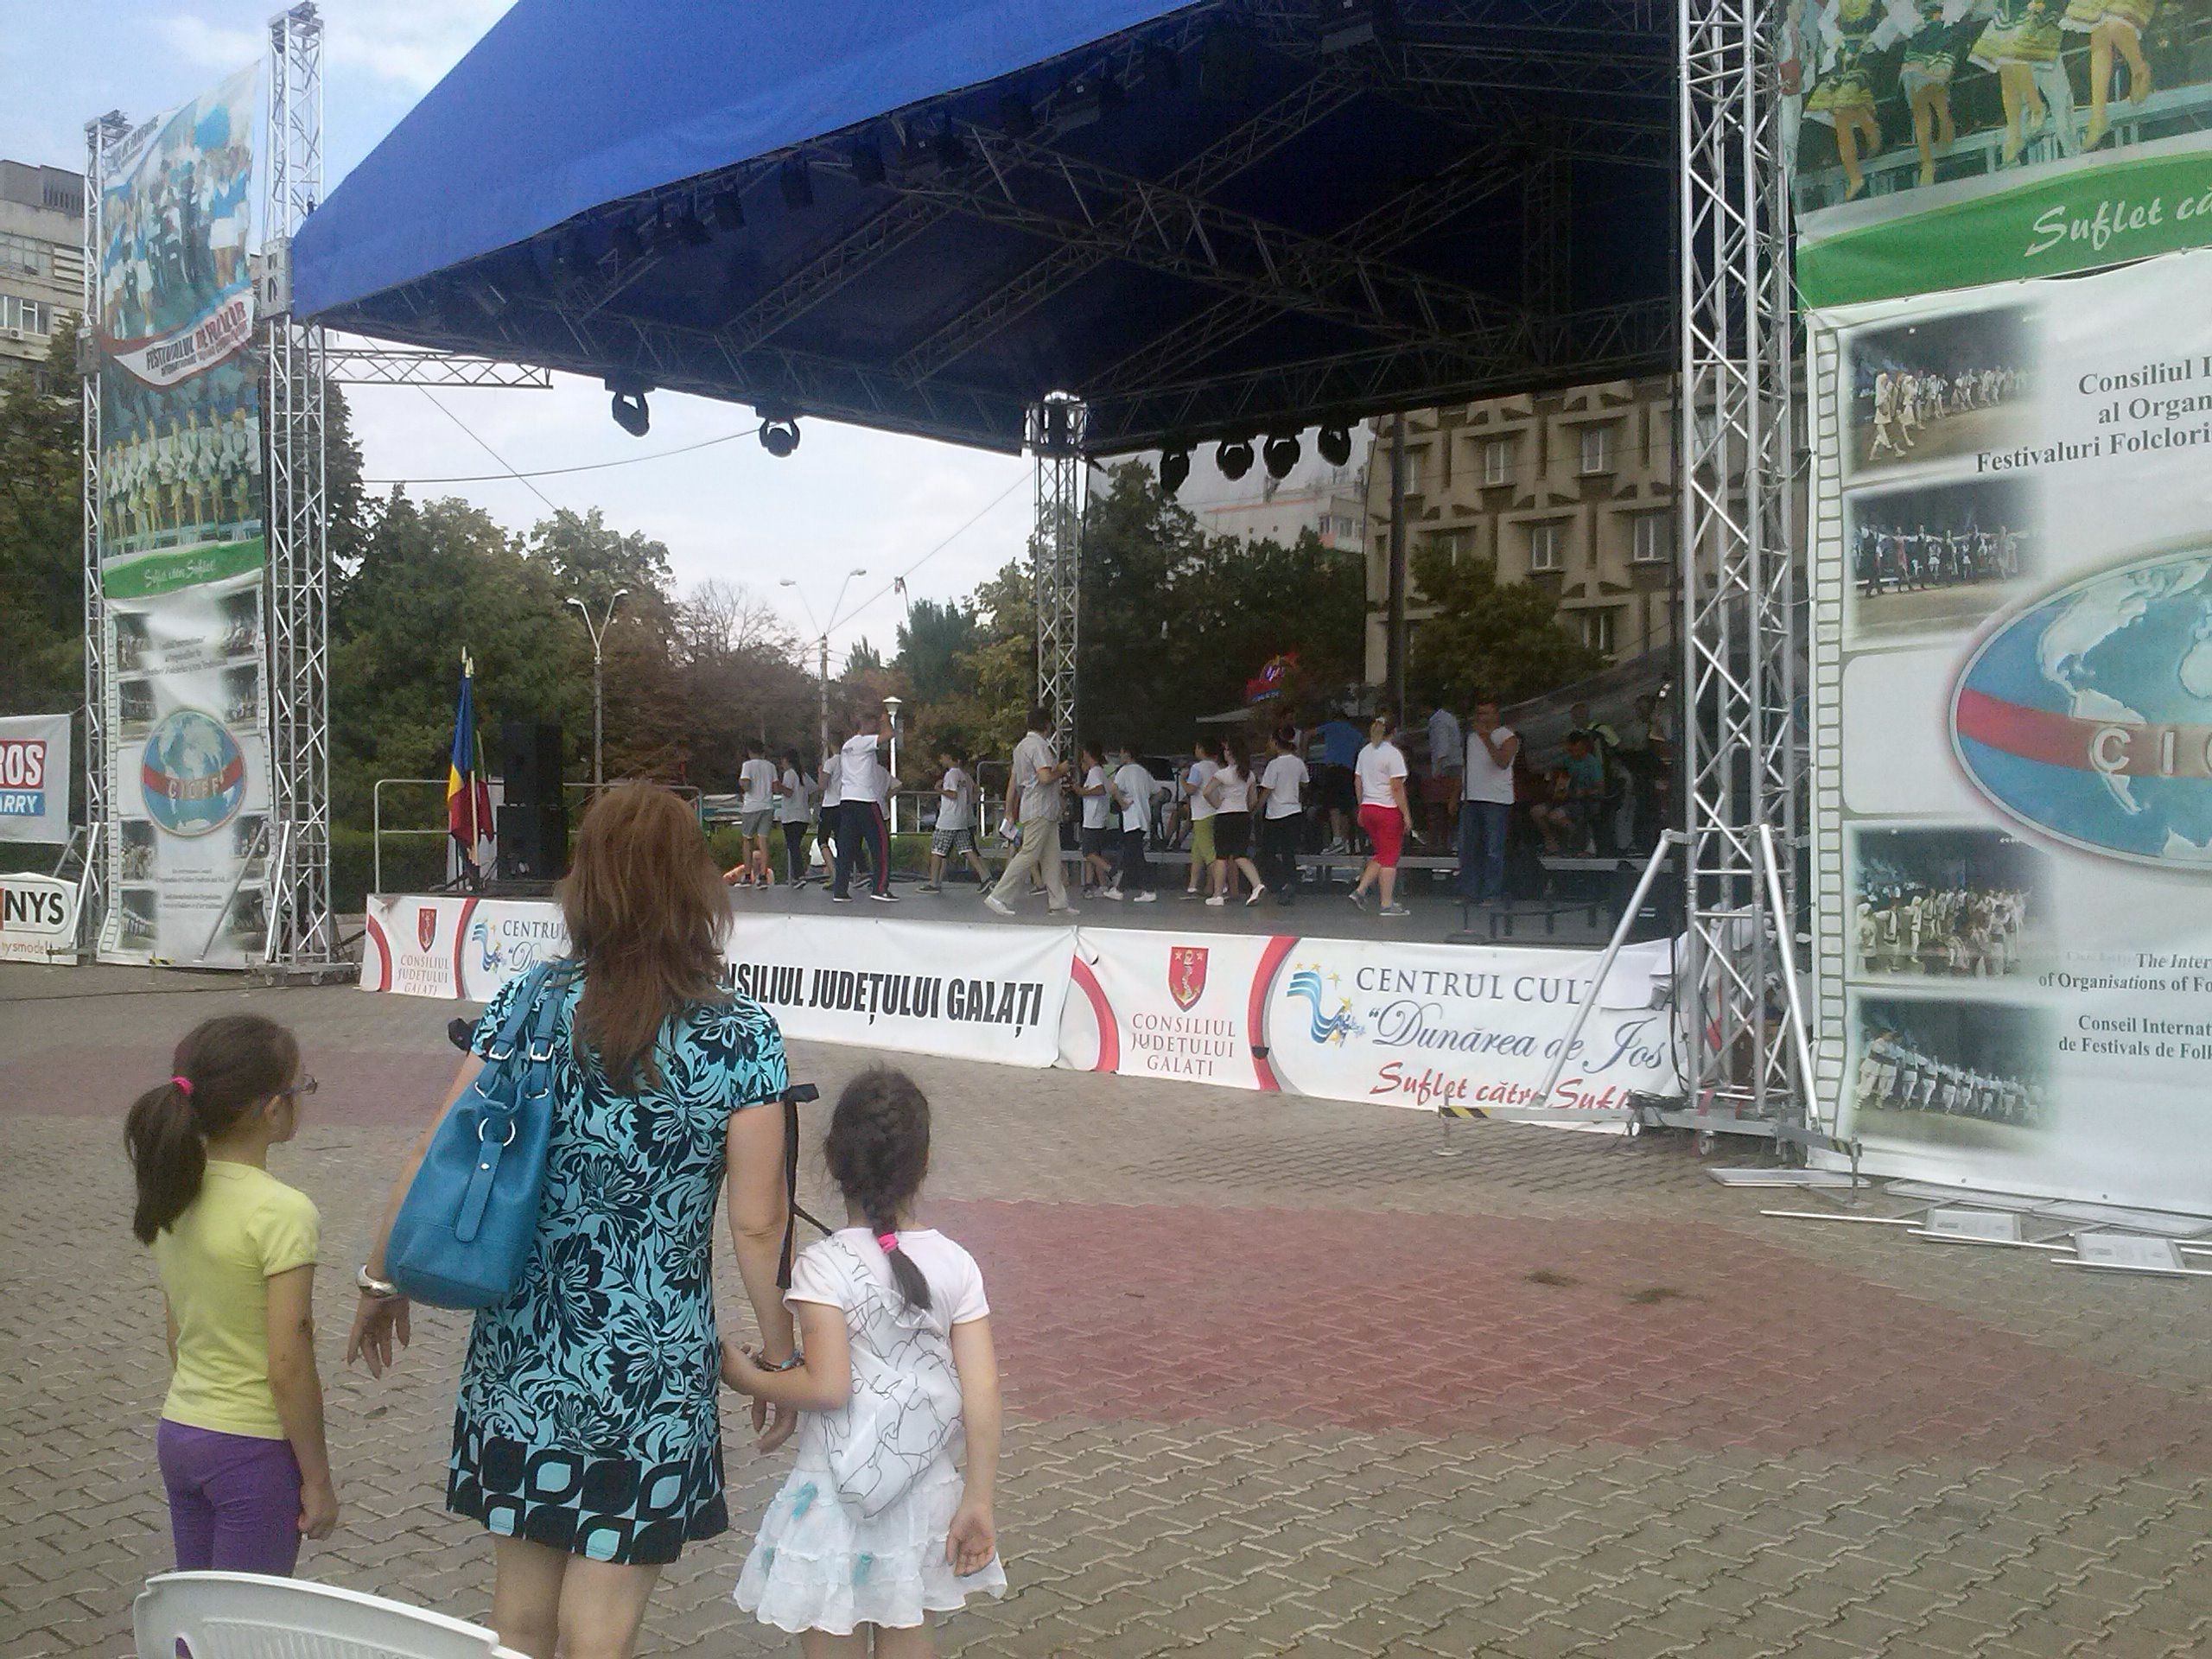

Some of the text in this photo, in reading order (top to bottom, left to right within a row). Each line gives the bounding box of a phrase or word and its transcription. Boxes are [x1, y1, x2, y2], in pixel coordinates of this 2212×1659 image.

[2024, 198, 2163, 257] Suflet
[2079, 359, 2191, 395] Consiliul
[2098, 394, 2212, 424] al Organ
[1977, 422, 2210, 473] Festivaluri Folclori
[2089, 727, 2212, 776] CI
[400, 954, 449, 969] CONSILIUL
[2136, 953, 2167, 969] The
[2171, 954, 2212, 969] Inter
[1357, 966, 1594, 1006] CENTRUL CUL
[2039, 971, 2055, 987] of
[2058, 973, 2166, 992] Organisations
[2171, 976, 2189, 992] of
[809, 968, 942, 1026] JUDEȚULUI
[946, 977, 1044, 1039] GALAȚI
[1132, 1013, 1236, 1038] CONSILIUL
[2078, 1014, 2212, 1037] Conseil Internat
[2058, 1036, 2076, 1052] de
[2082, 1037, 2150, 1057] Festivals
[2155, 1042, 2174, 1058] de
[1369, 1061, 1468, 1106] Suflet
[1549, 1077, 1631, 1109] Sufl
